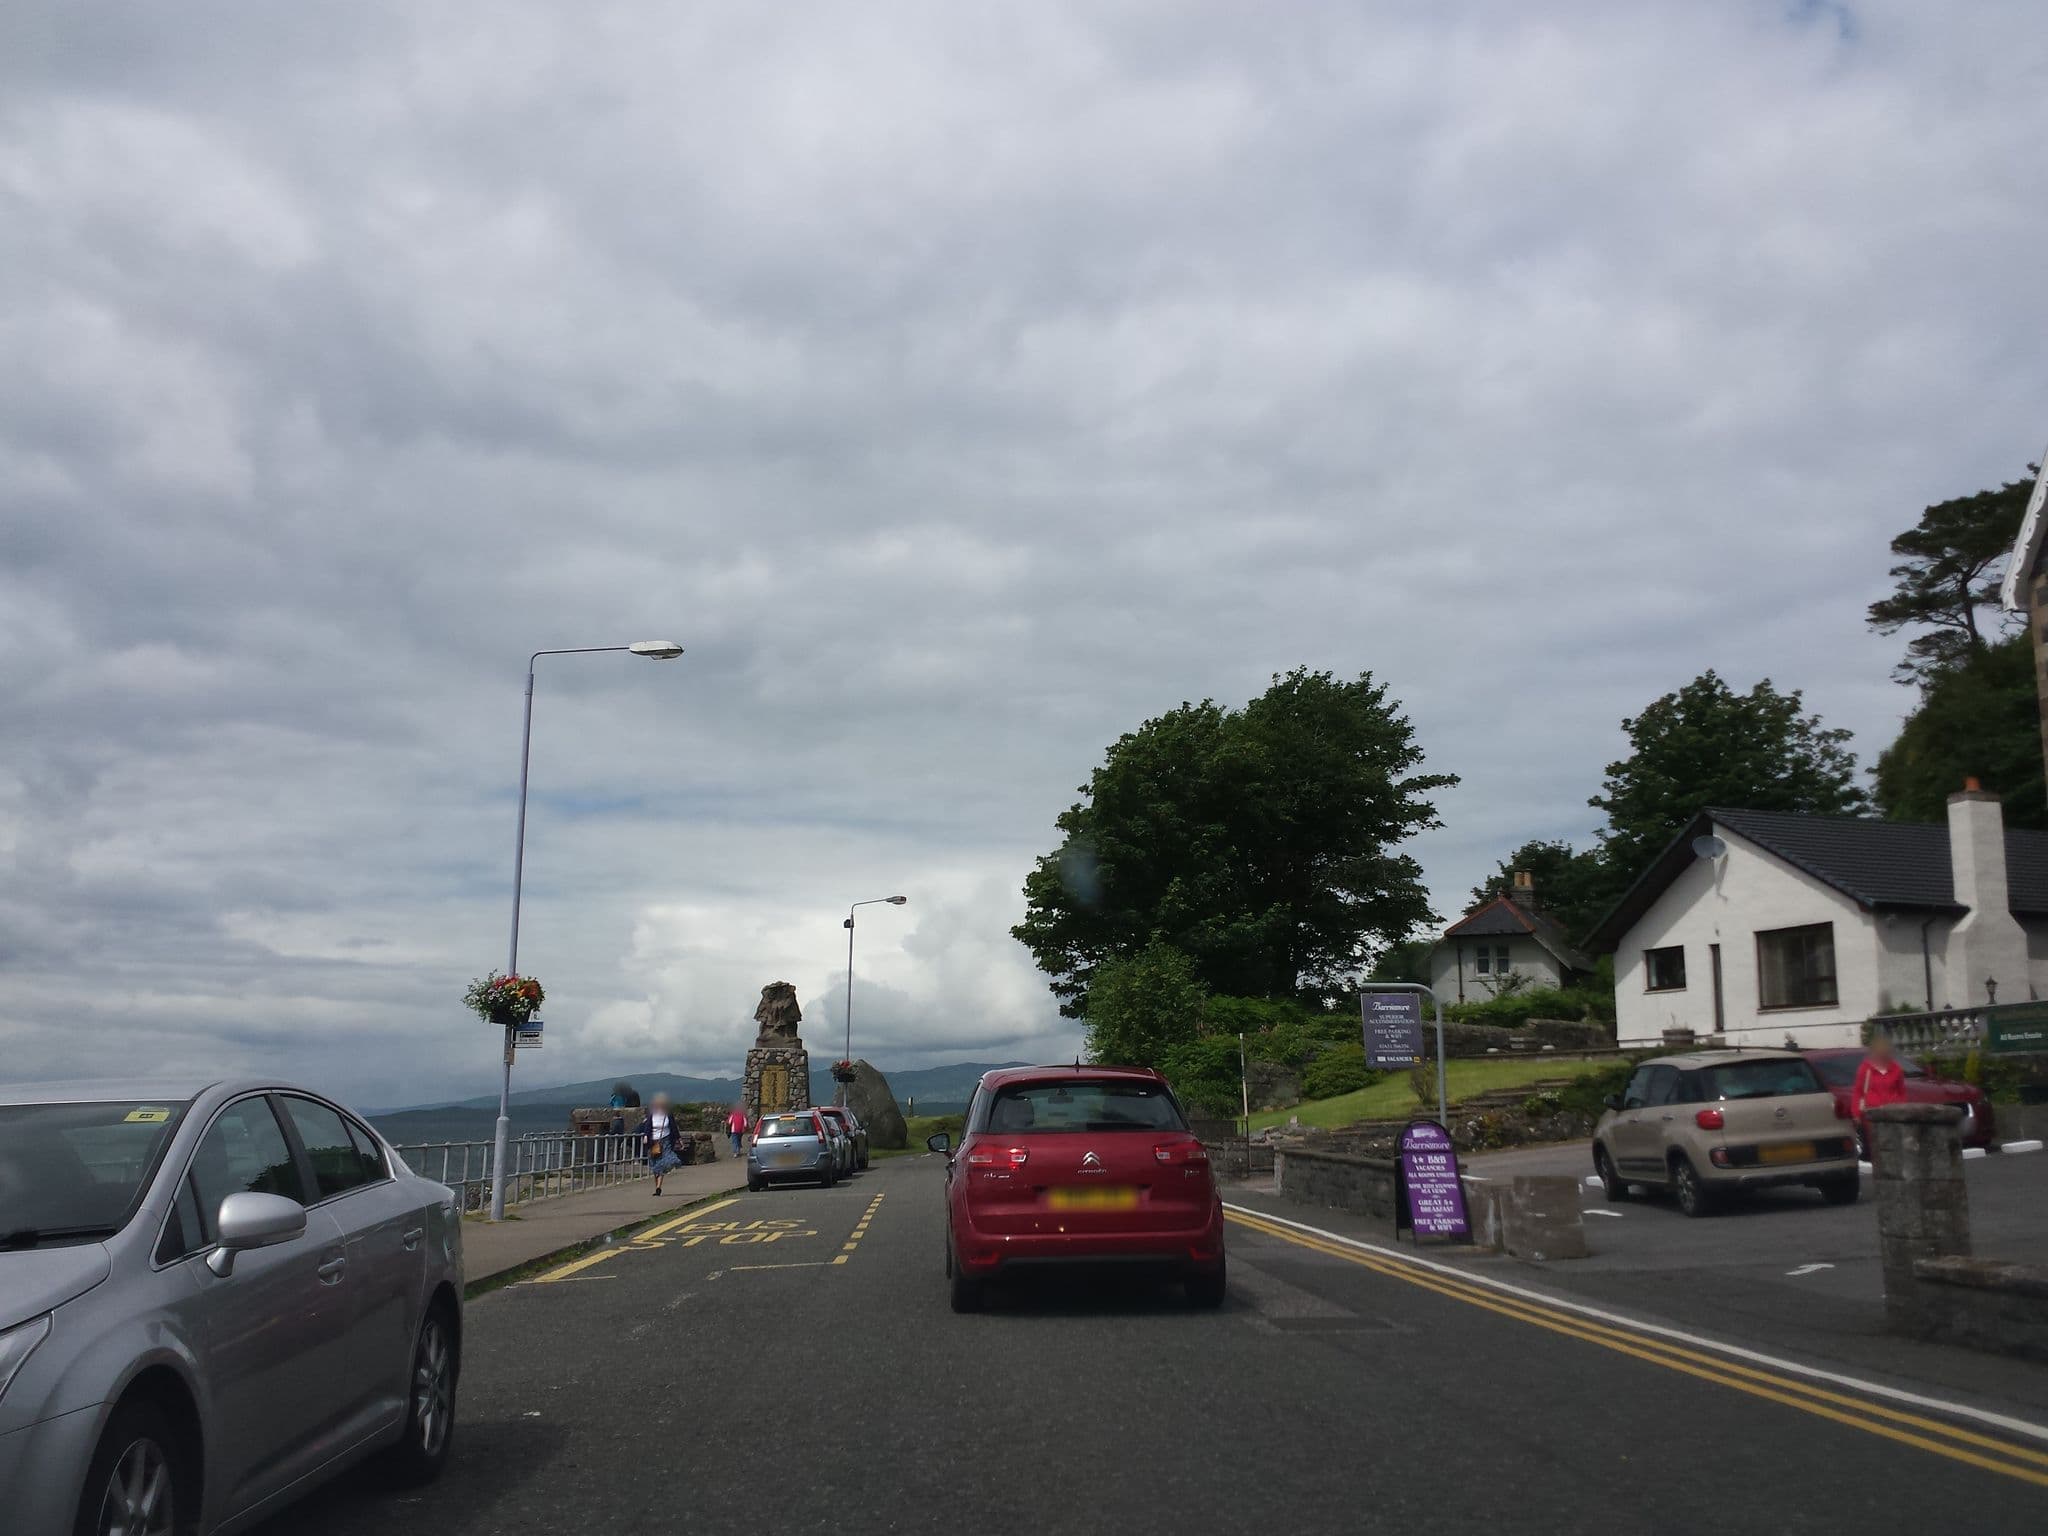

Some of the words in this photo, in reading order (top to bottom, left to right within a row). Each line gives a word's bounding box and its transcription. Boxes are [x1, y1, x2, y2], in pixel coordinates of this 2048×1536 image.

[1427, 1155, 1447, 1164] B&B
[675, 1219, 807, 1234] BUS
[619, 1230, 818, 1250] STOP
